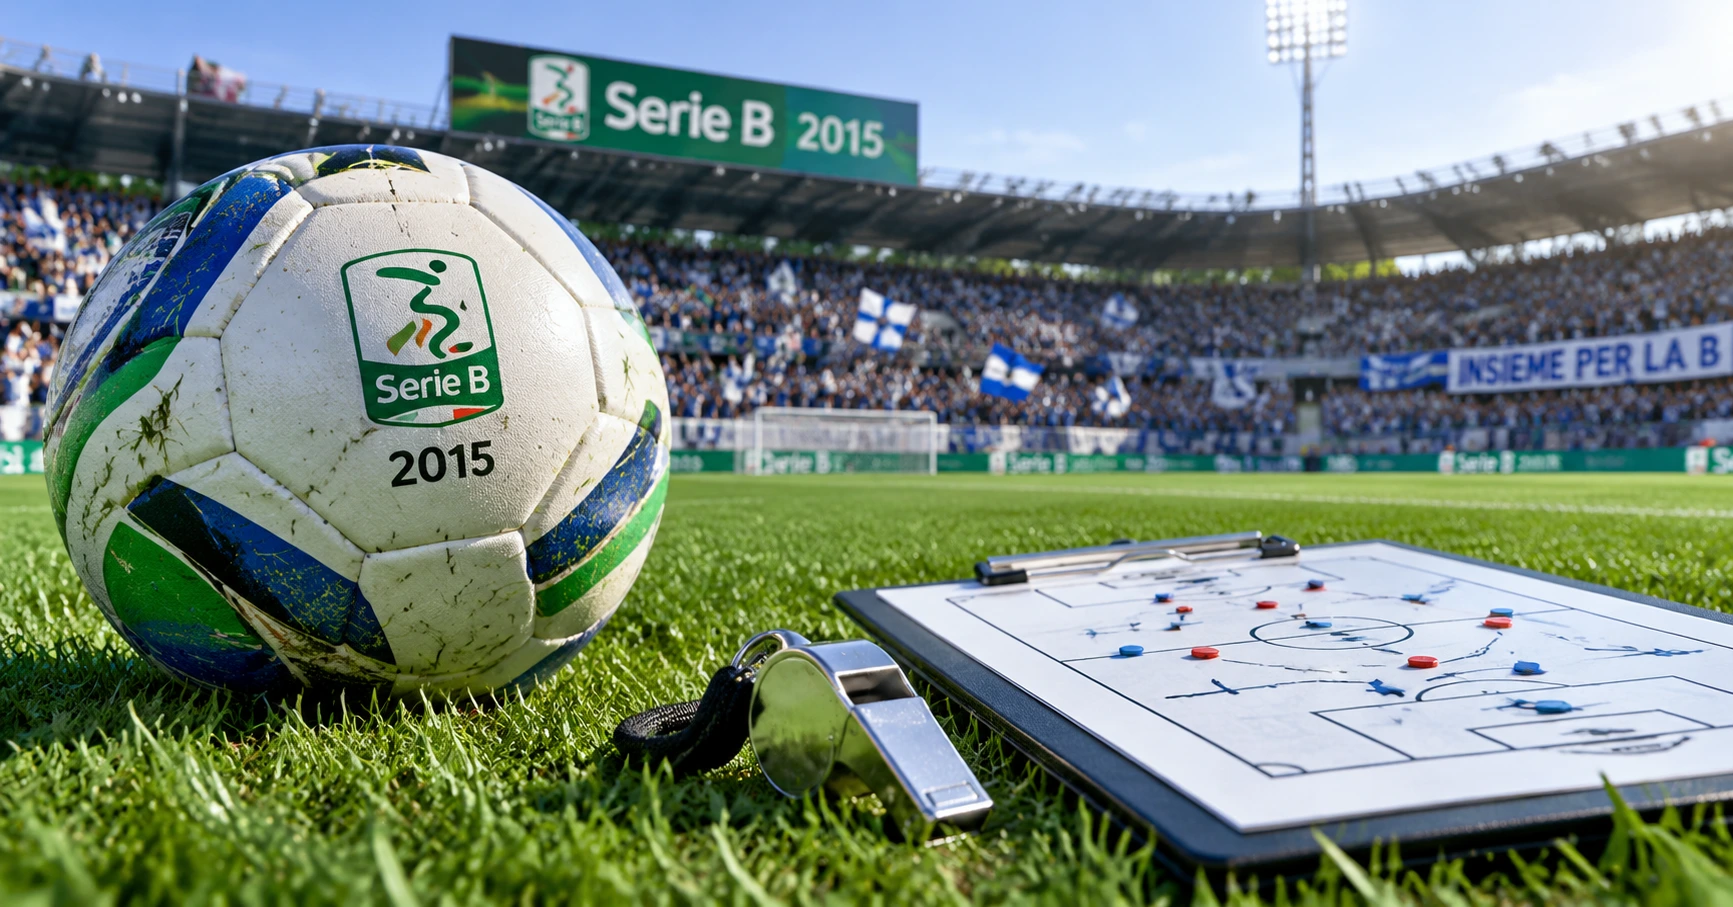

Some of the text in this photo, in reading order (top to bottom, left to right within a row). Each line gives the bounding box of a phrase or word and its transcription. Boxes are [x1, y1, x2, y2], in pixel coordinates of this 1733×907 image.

[604, 80, 885, 159] Serie B 2015
[1458, 334, 1720, 386] INSIEME PER LA B
[375, 365, 491, 404] Serie B
[389, 440, 495, 487] 2015
[1458, 453, 1498, 473] Serie
